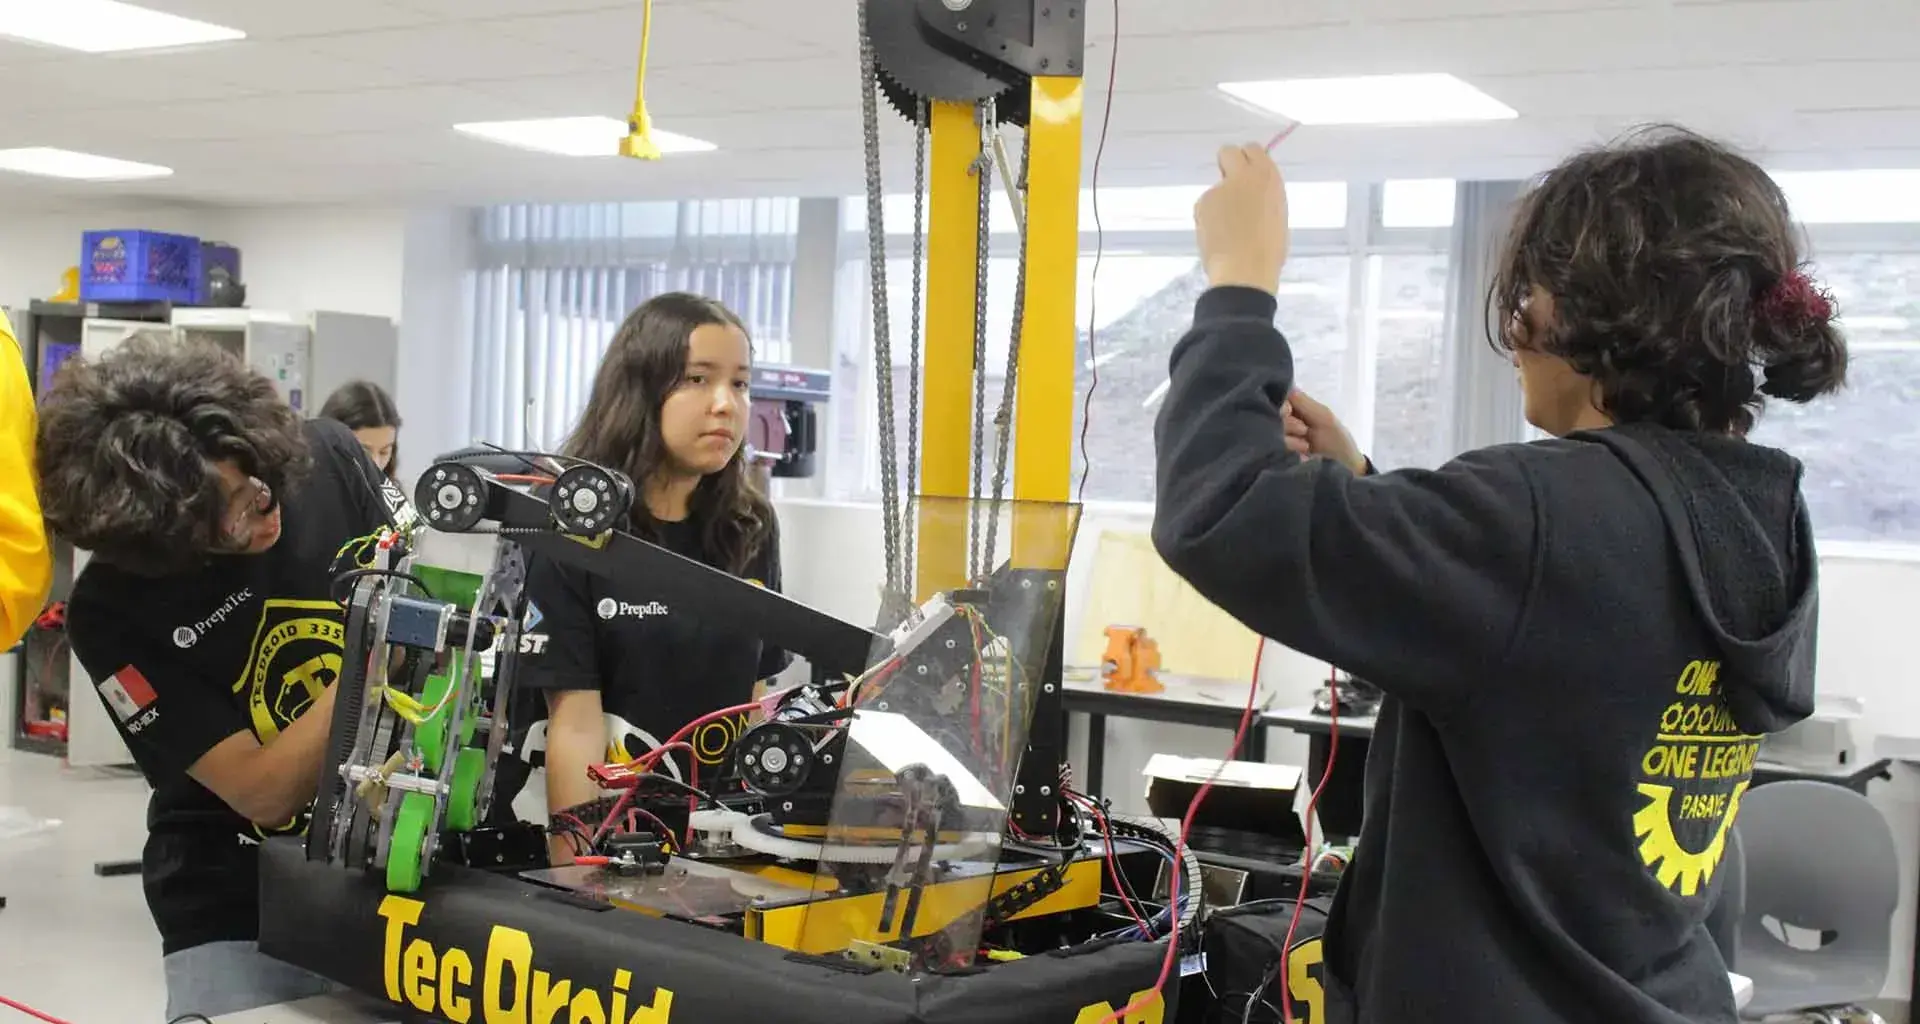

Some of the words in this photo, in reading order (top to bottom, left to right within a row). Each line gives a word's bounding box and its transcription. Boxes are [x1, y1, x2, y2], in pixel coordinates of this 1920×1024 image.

[194, 586, 253, 635] PrepaTec
[619, 602, 669, 619] PrepaTec
[253, 624, 298, 706] TECDROID
[1642, 745, 1699, 779] ONE
[377, 895, 473, 1024] Tec
